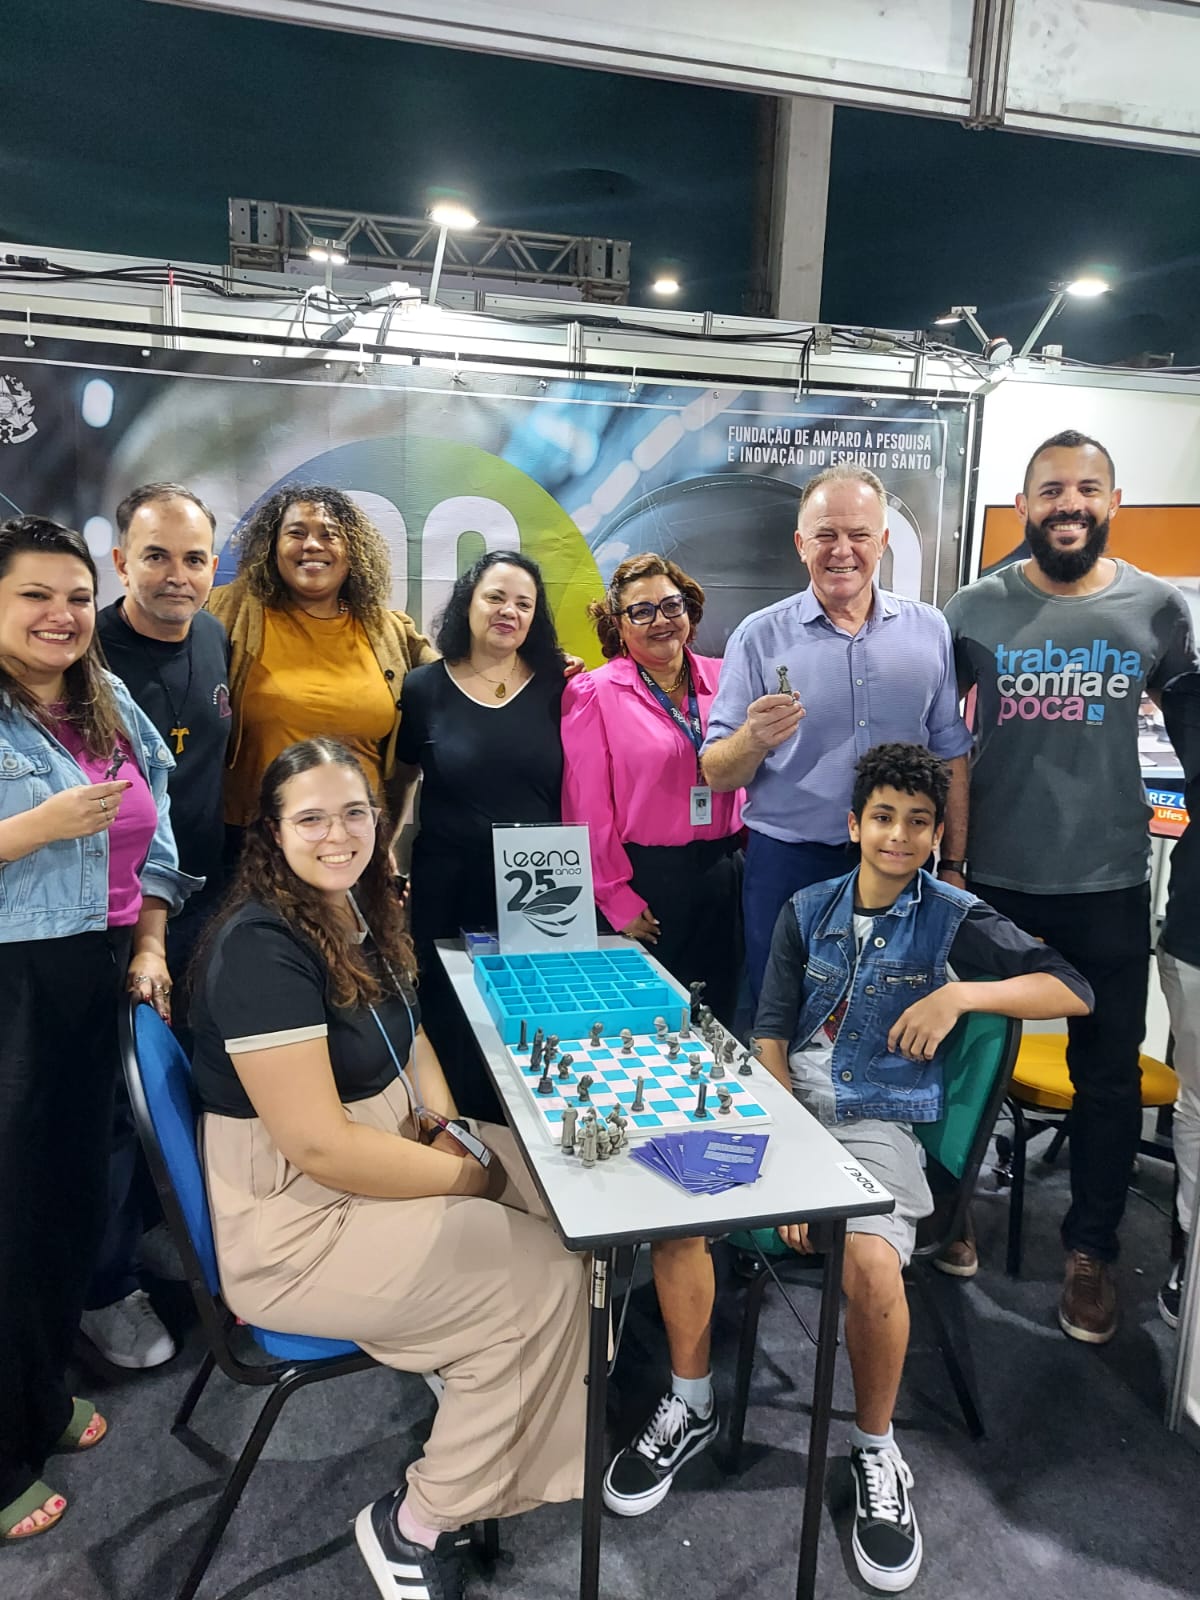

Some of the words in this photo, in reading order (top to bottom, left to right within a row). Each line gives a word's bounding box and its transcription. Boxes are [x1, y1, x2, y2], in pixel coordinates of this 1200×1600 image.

[728, 426, 790, 447] FUNDAÇÃO
[795, 429, 809, 446] DE
[813, 430, 860, 448] AMPARO
[864, 430, 873, 449] À
[876, 433, 932, 451] PESQUISA
[727, 446, 735, 463] E
[740, 446, 804, 467] INOVAÇÃO
[809, 450, 825, 466] DO
[830, 449, 887, 469] ESPÍRITO
[891, 453, 931, 470] SANTO
[994, 639, 1145, 682] trabalha,
[996, 662, 1103, 698] confia
[1106, 673, 1130, 699] e
[996, 696, 1085, 726] poca
[1157, 809, 1183, 821] Ufes
[504, 869, 557, 912] 25
